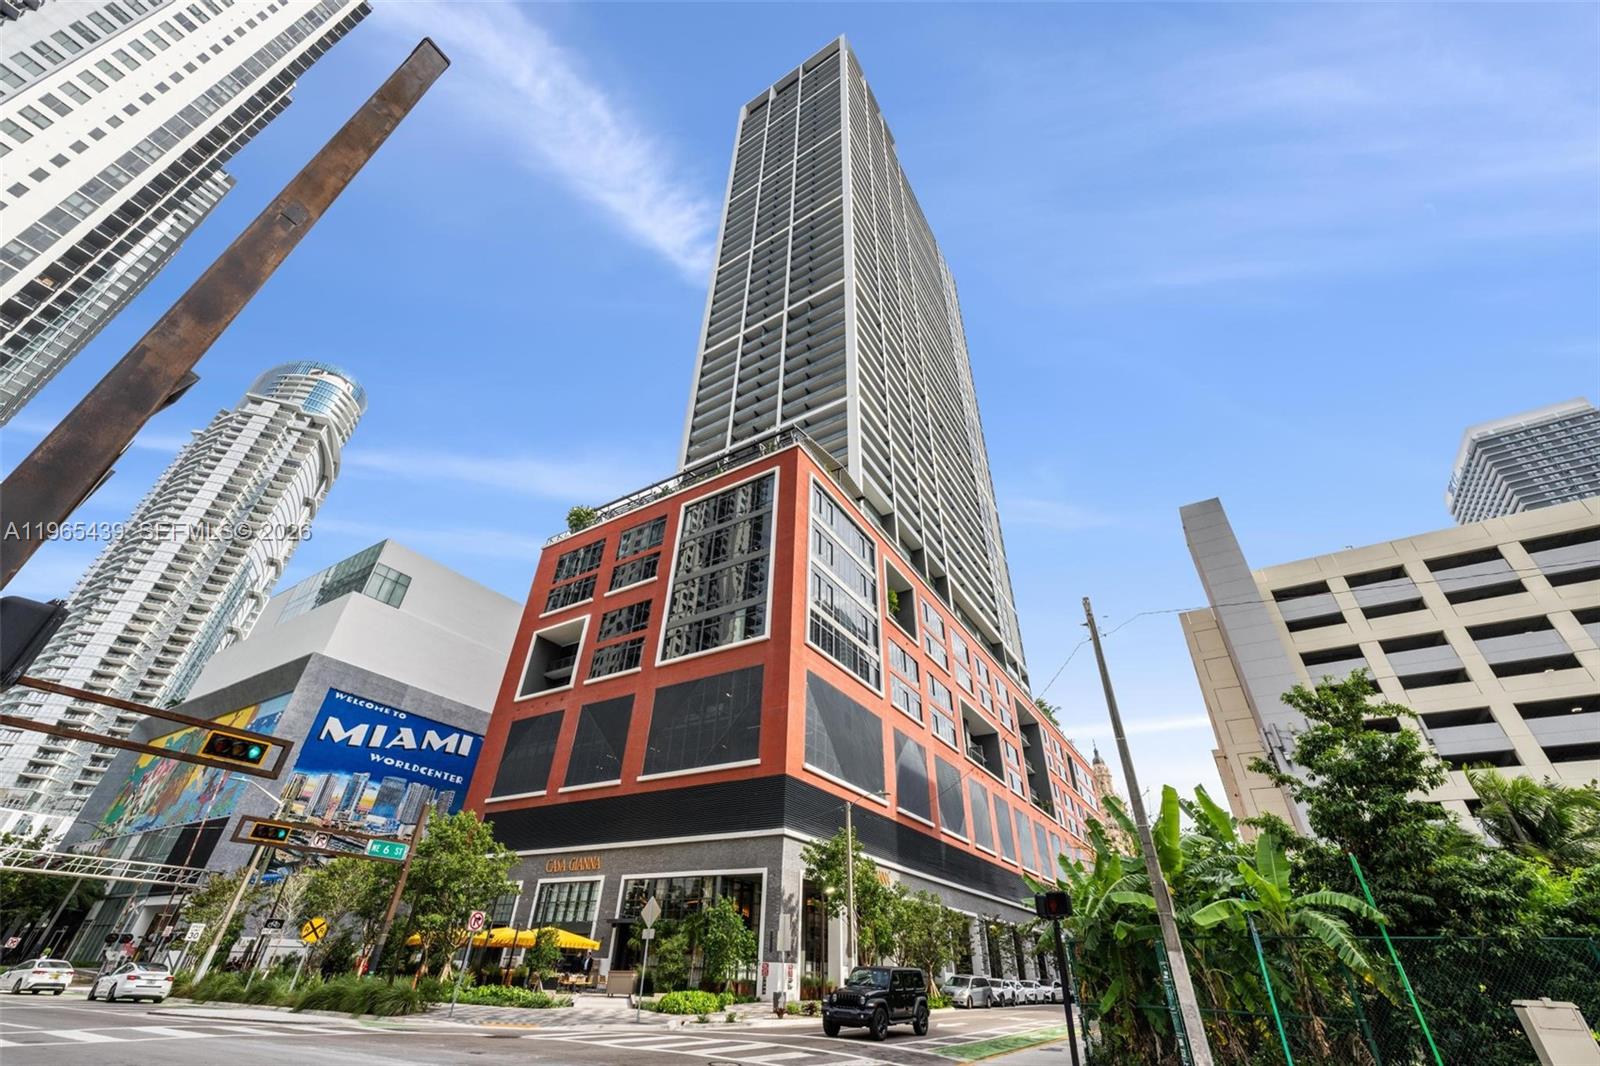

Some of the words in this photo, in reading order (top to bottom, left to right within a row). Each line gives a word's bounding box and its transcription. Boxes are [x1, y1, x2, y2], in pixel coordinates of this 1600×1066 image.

[335, 692, 390, 714] WELCOME
[393, 711, 407, 719] TO
[319, 716, 474, 757] MIAMI
[369, 753, 464, 784] WORLDCENTER
[371, 844, 381, 853] NE
[383, 845, 390, 855] 6
[394, 847, 404, 856] ST
[569, 856, 601, 871] GIANNA
[188, 931, 200, 940] 30
